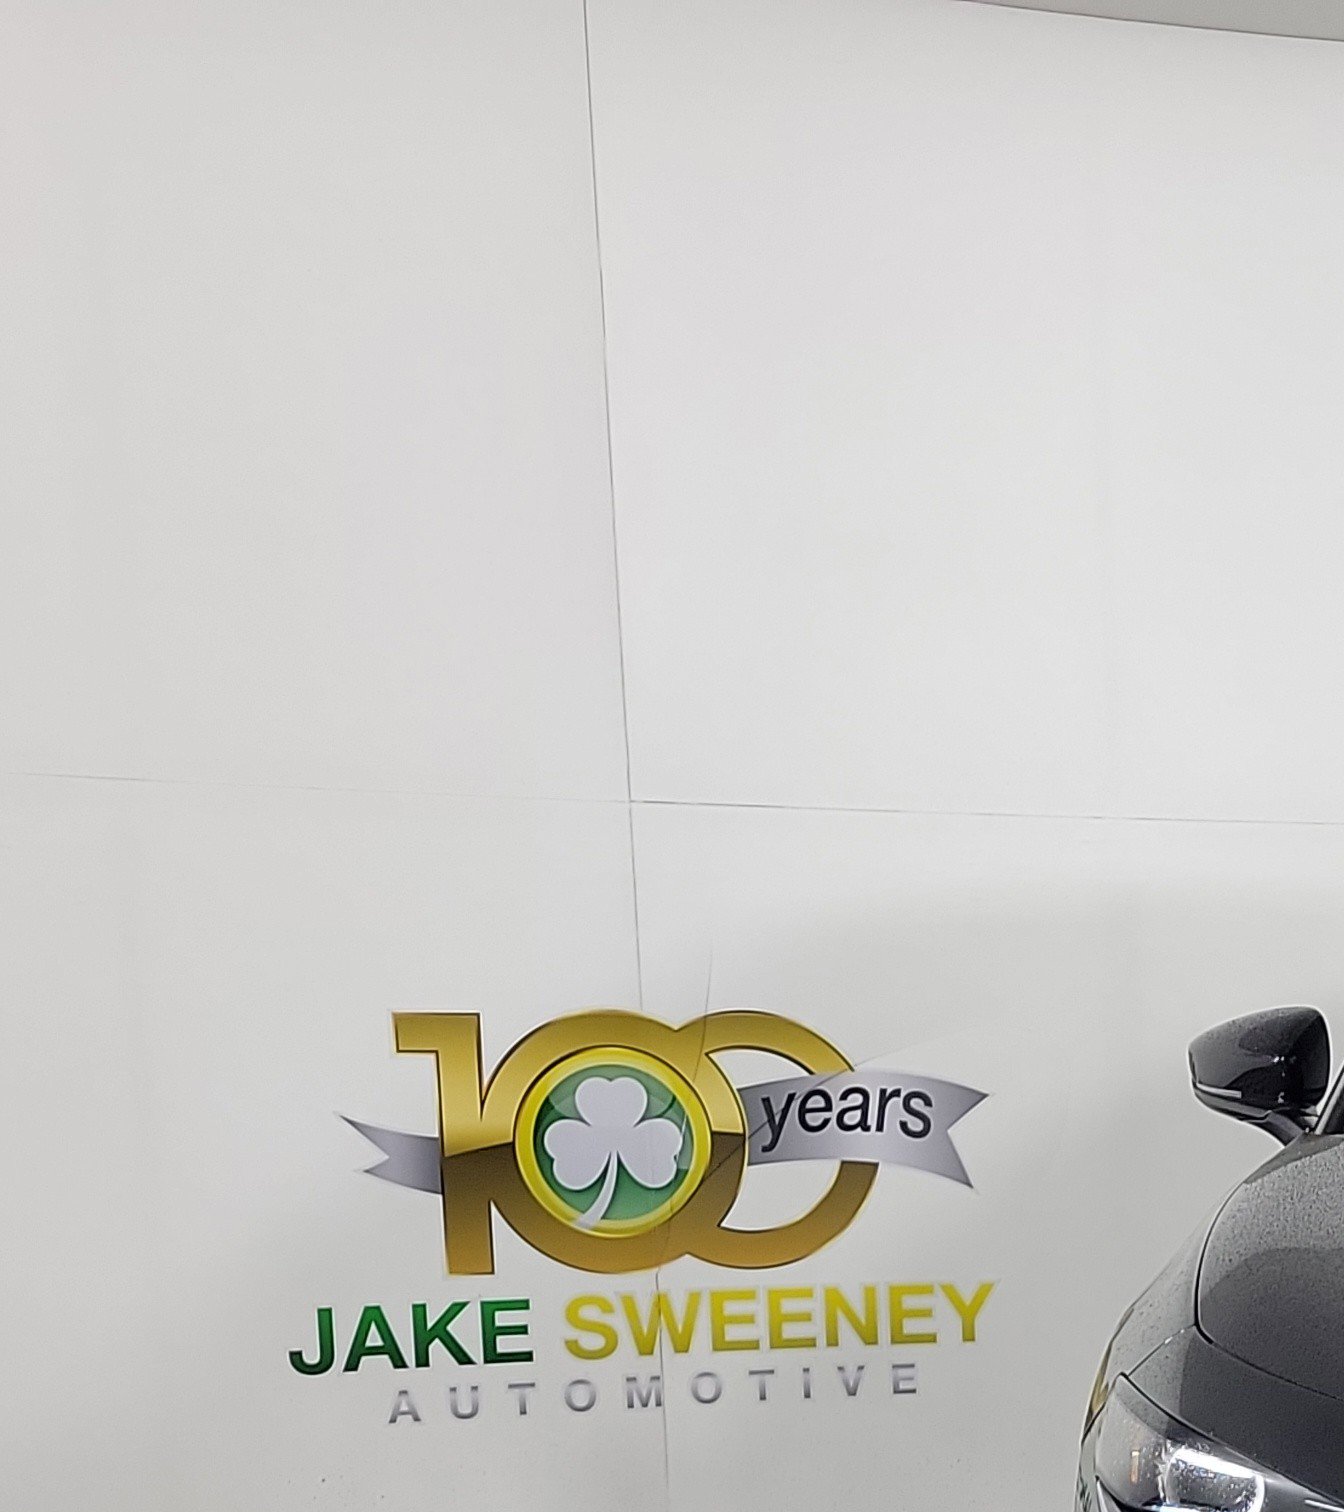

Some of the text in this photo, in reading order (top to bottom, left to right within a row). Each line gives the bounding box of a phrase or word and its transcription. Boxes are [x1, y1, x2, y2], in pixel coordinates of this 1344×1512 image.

[393, 1009, 934, 1275] 100 years
[288, 1282, 995, 1376] JAKE SWEENEY
[388, 1363, 919, 1425] AUTOMOTIVE
